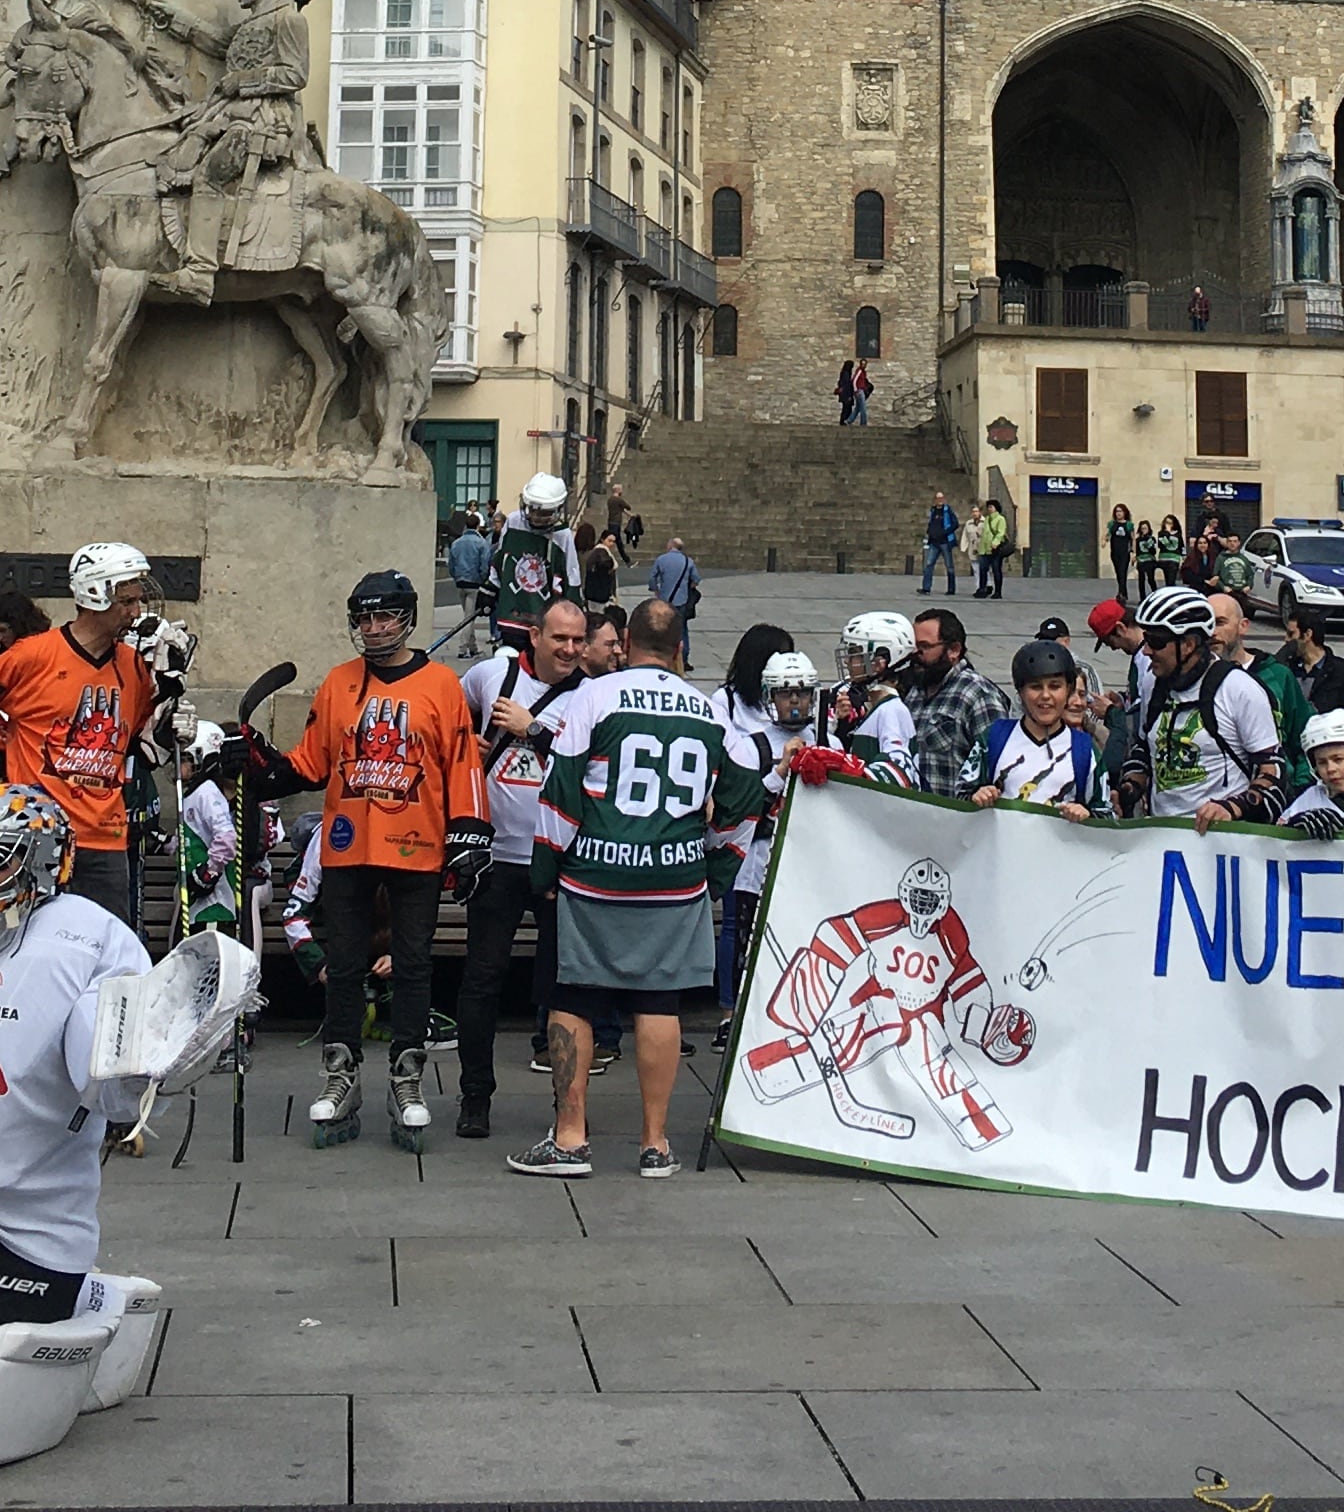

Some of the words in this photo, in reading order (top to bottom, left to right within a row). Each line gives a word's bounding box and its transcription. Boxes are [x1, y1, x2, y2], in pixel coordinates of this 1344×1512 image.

[619, 688, 715, 720] ARTEAGA
[614, 732, 708, 819] 69
[444, 832, 491, 847] AUER
[575, 834, 655, 867] VITORIA
[886, 945, 941, 985] SOS
[31, 1346, 94, 1362] BAUER
